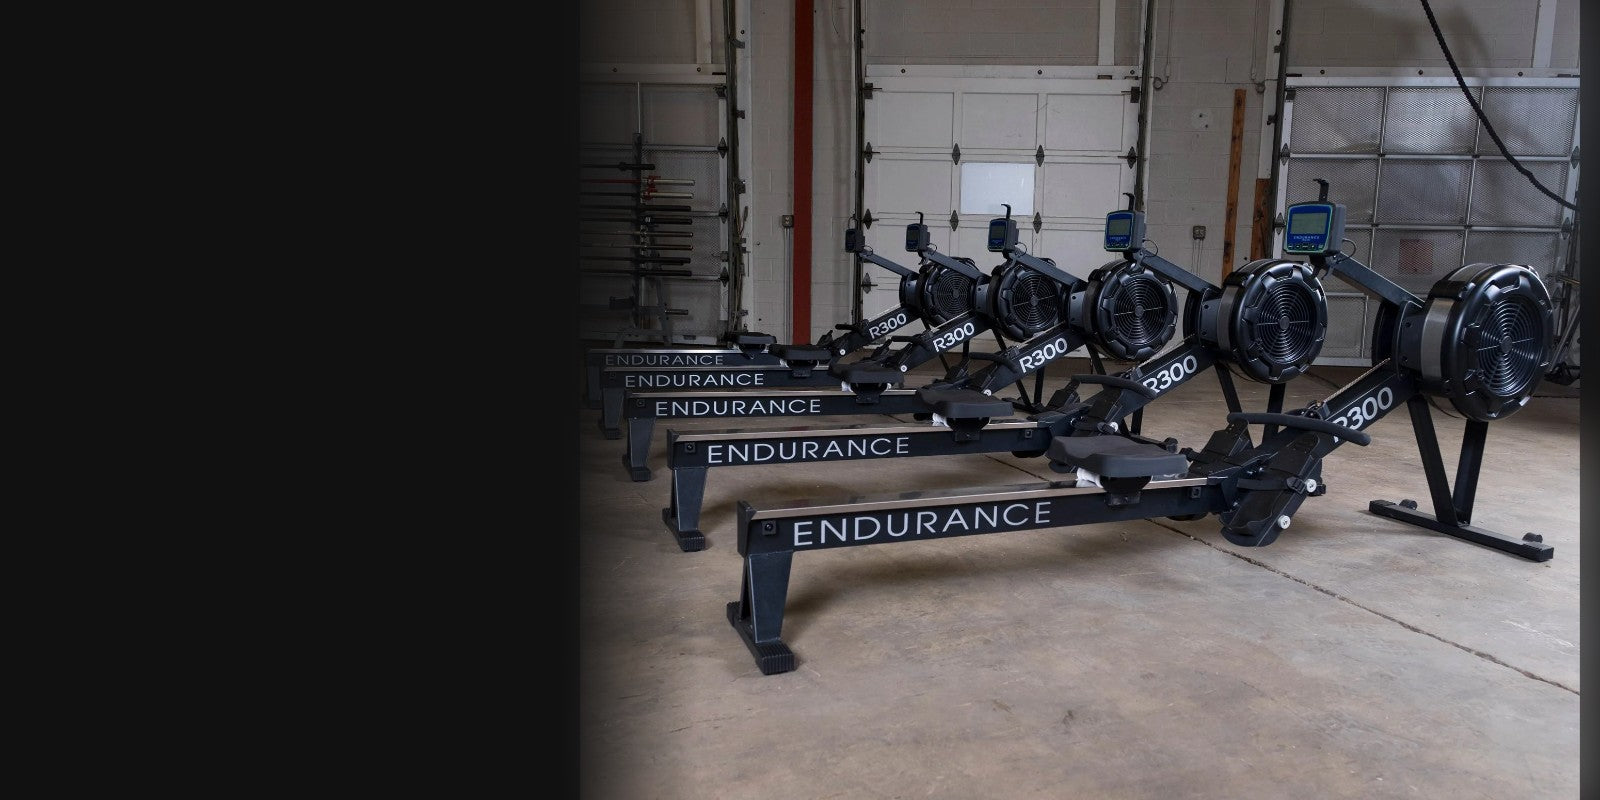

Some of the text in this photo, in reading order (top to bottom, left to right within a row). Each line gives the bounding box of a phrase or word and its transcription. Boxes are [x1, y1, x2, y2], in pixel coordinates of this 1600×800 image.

[868, 313, 907, 339] R300
[932, 322, 975, 352] R300
[604, 354, 724, 367] ENDURANCE
[1018, 337, 1068, 374] R300
[625, 373, 764, 388] ENDURANCE
[655, 399, 821, 416] ENDURANCE
[708, 437, 910, 464] ENDURANCE
[793, 501, 1052, 546] ENDURANCE
